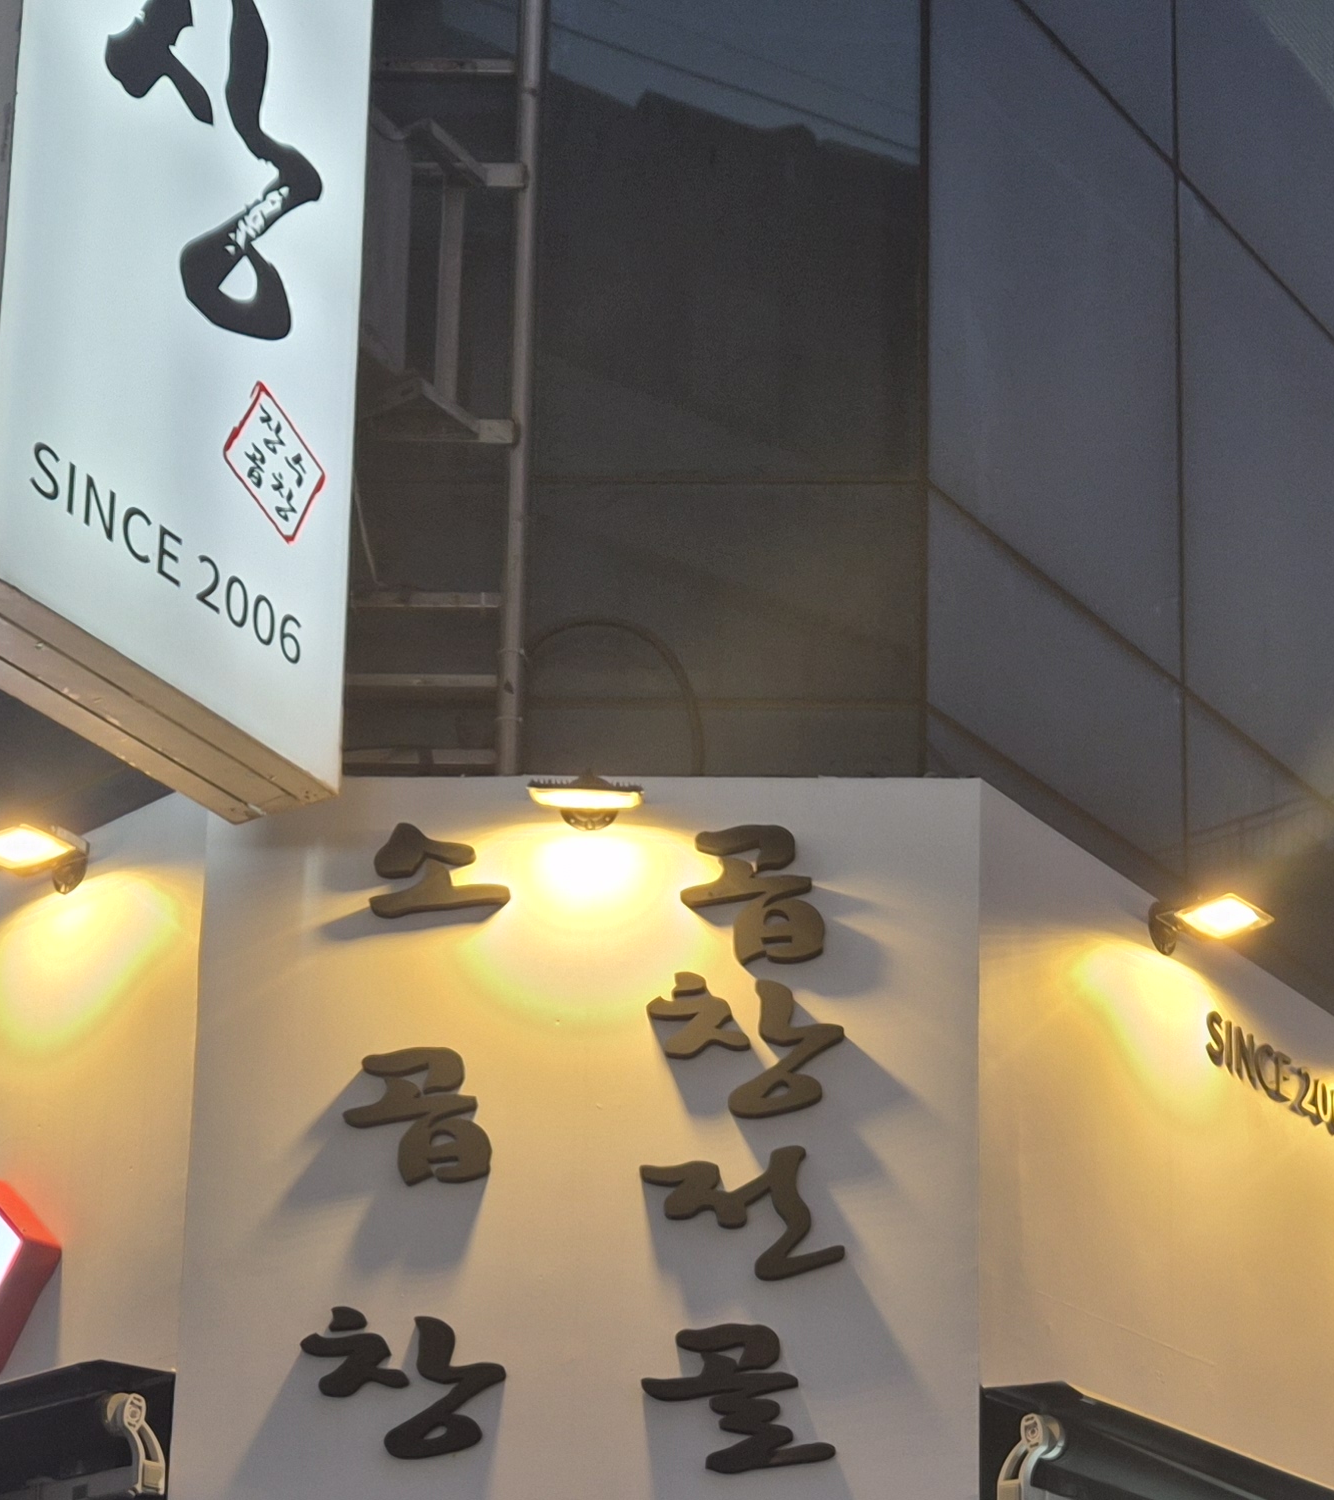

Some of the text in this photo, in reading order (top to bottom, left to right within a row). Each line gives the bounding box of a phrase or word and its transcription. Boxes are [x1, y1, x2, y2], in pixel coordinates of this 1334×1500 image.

[28, 441, 302, 665] SINCE 2006
[1206, 1010, 1291, 1103] SINCE
